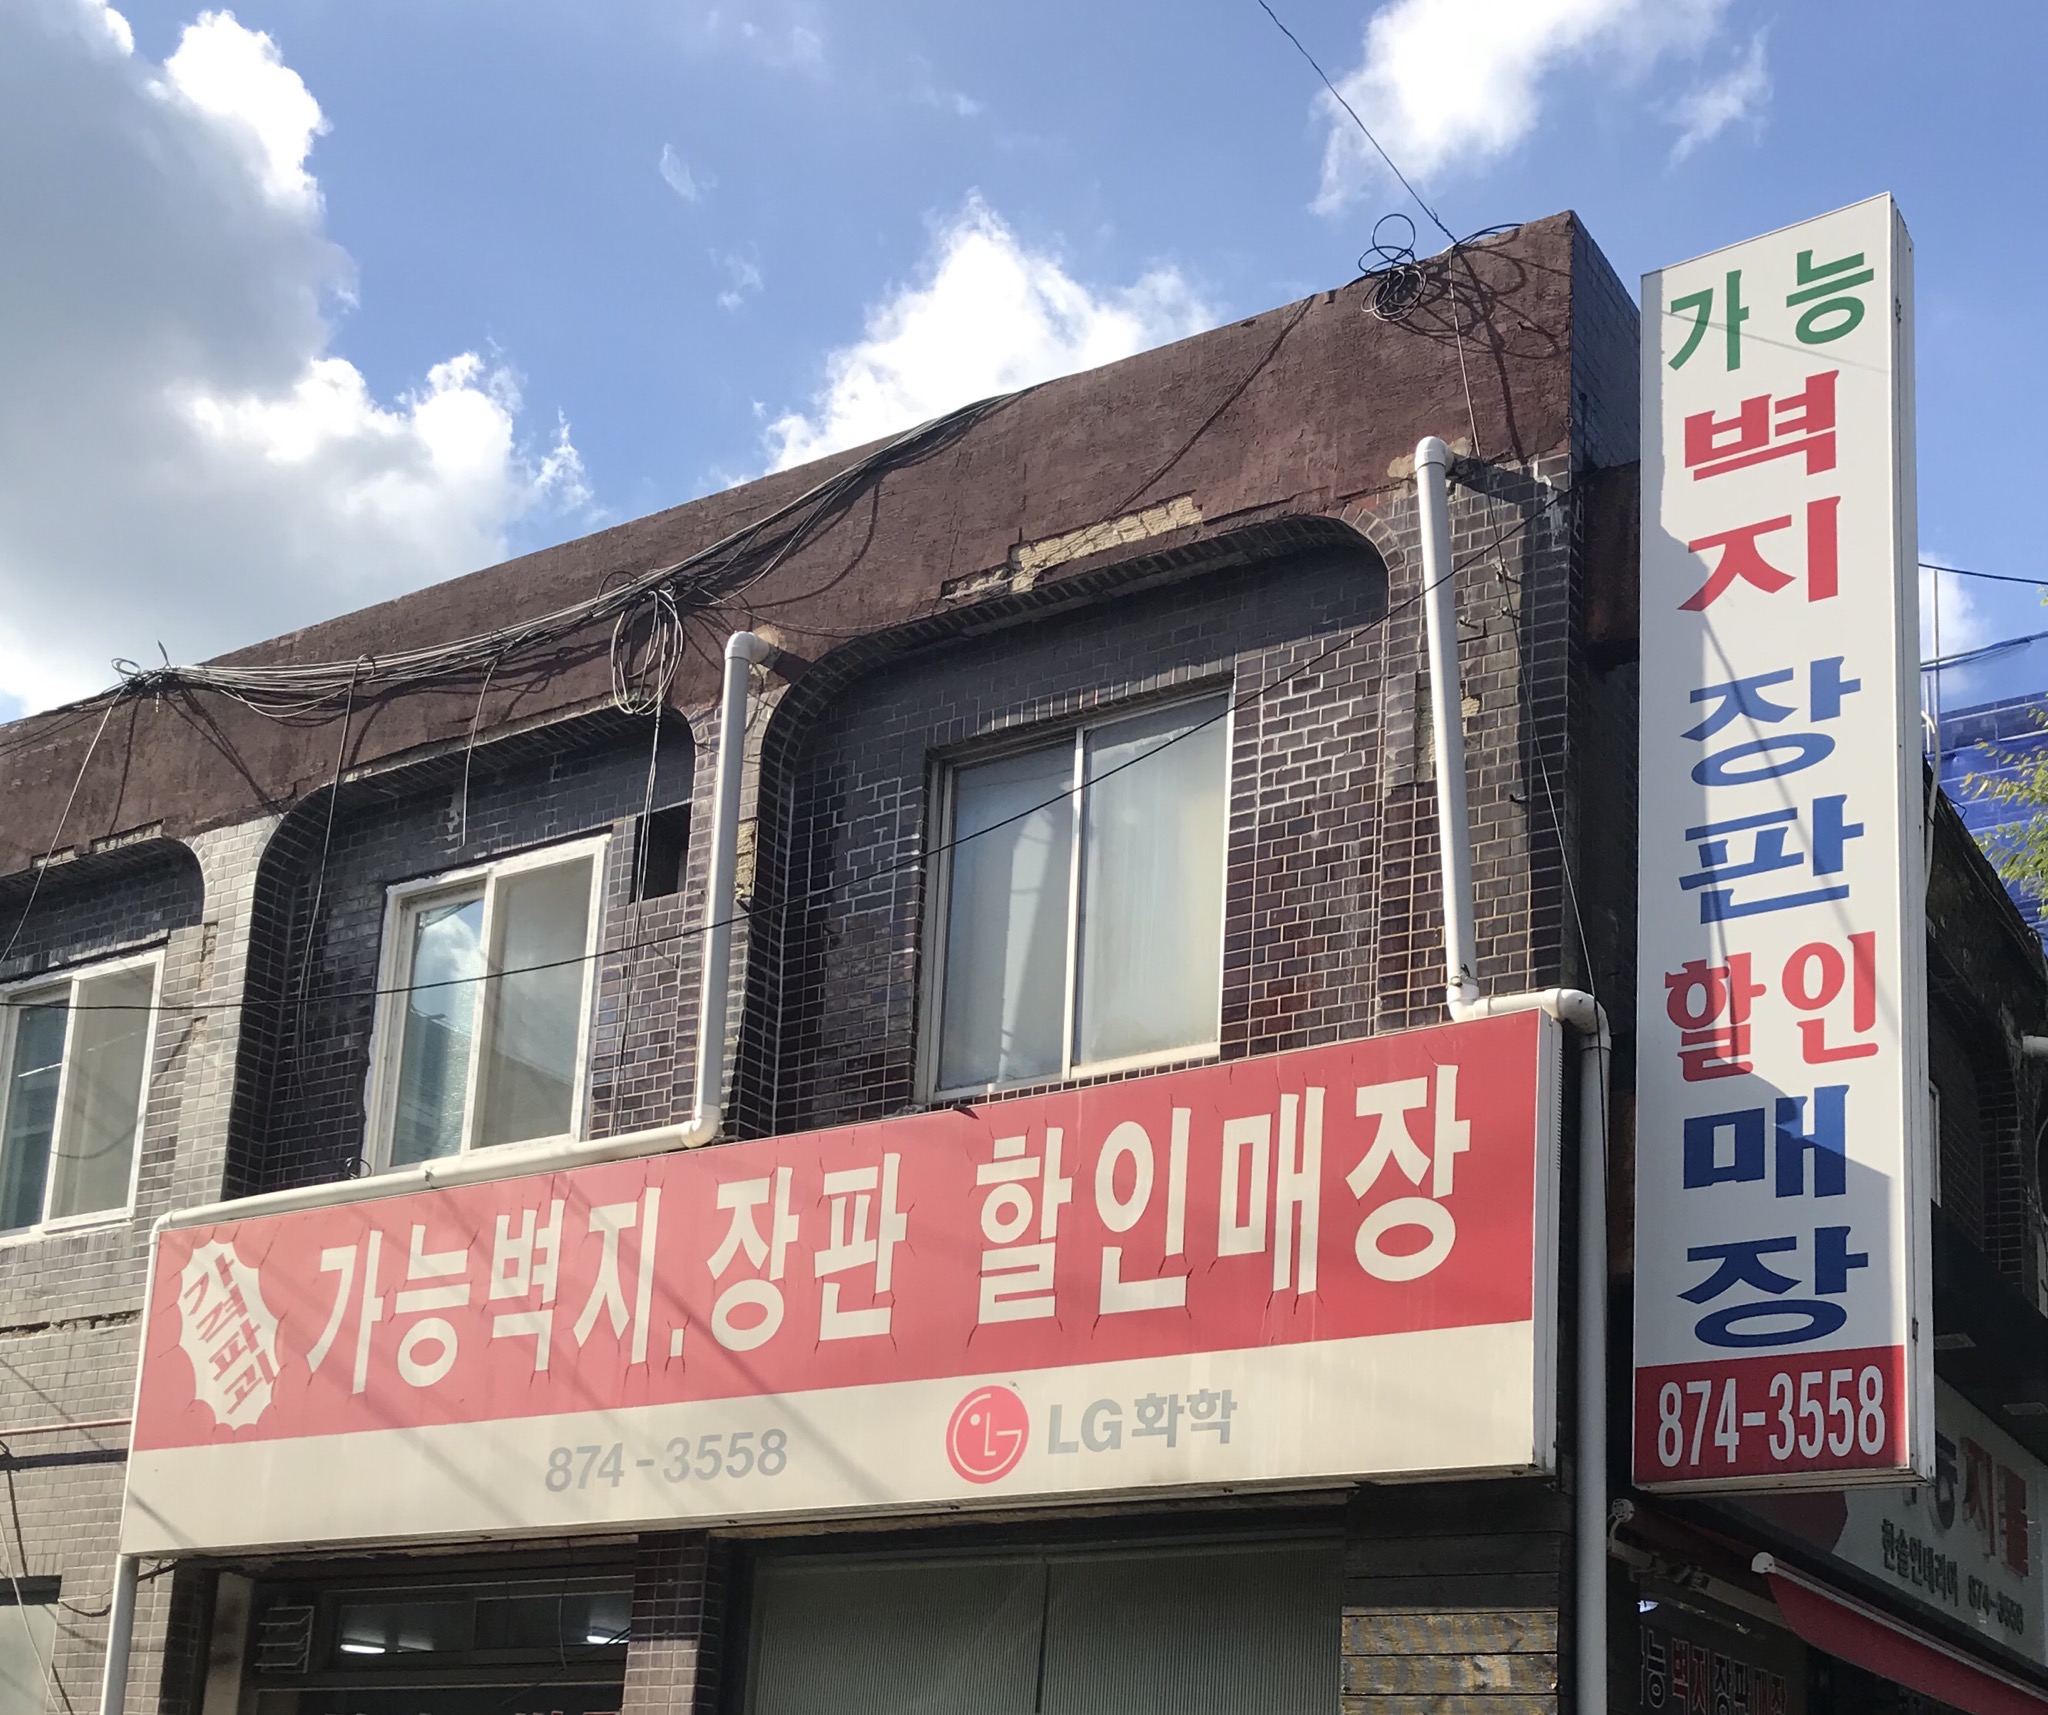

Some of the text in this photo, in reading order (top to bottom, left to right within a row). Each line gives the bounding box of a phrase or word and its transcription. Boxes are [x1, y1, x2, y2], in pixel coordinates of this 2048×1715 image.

[1668, 249, 1874, 372] 가능
[1677, 369, 1864, 924] 벽지 장판
[1664, 931, 1879, 1082] 할인
[975, 1064, 1471, 1325] 할인매장
[1677, 1084, 1868, 1348] 매장
[183, 1252, 277, 1415] 가격파괴
[545, 1428, 788, 1493] 874-3558
[1048, 1388, 1238, 1456] LG화학
[1657, 1365, 1886, 1468] 874-3558
